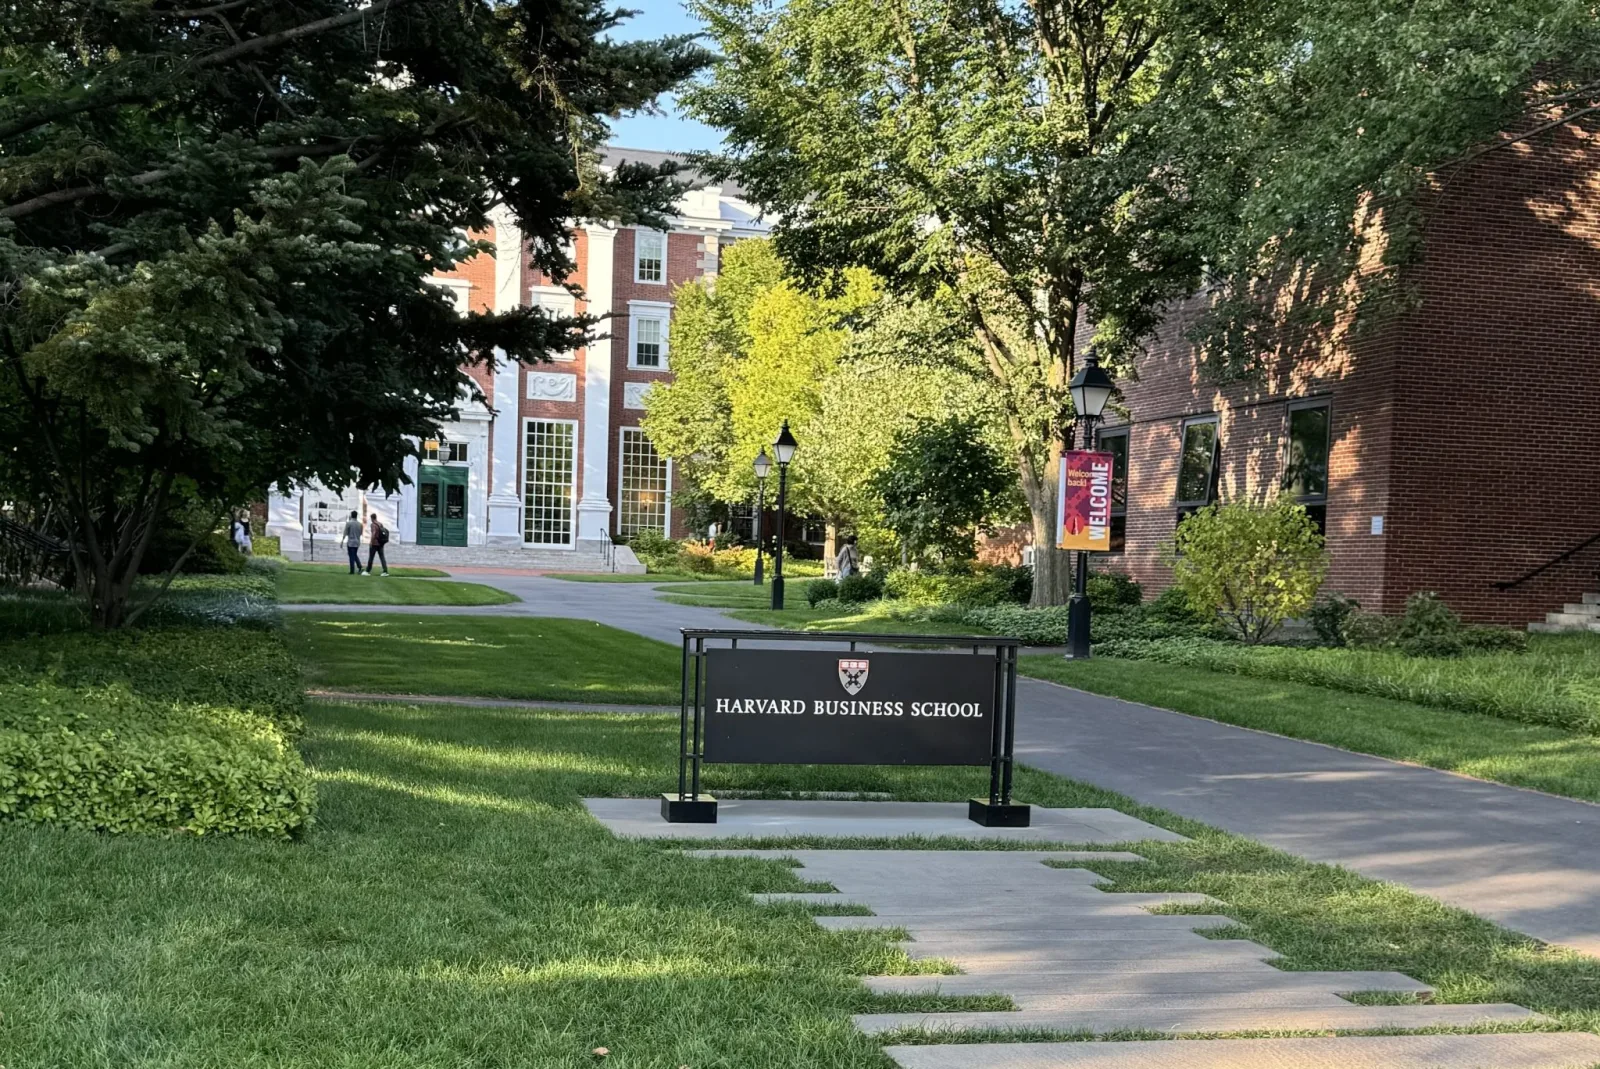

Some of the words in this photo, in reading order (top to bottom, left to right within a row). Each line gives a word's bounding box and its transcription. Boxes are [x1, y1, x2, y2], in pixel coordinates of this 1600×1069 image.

[1067, 478, 1087, 487] back!
[1089, 462, 1109, 540] WELCOME
[716, 698, 806, 715] HARVARD
[814, 700, 904, 717] BUSINESS
[911, 702, 983, 718] SCHOOL
